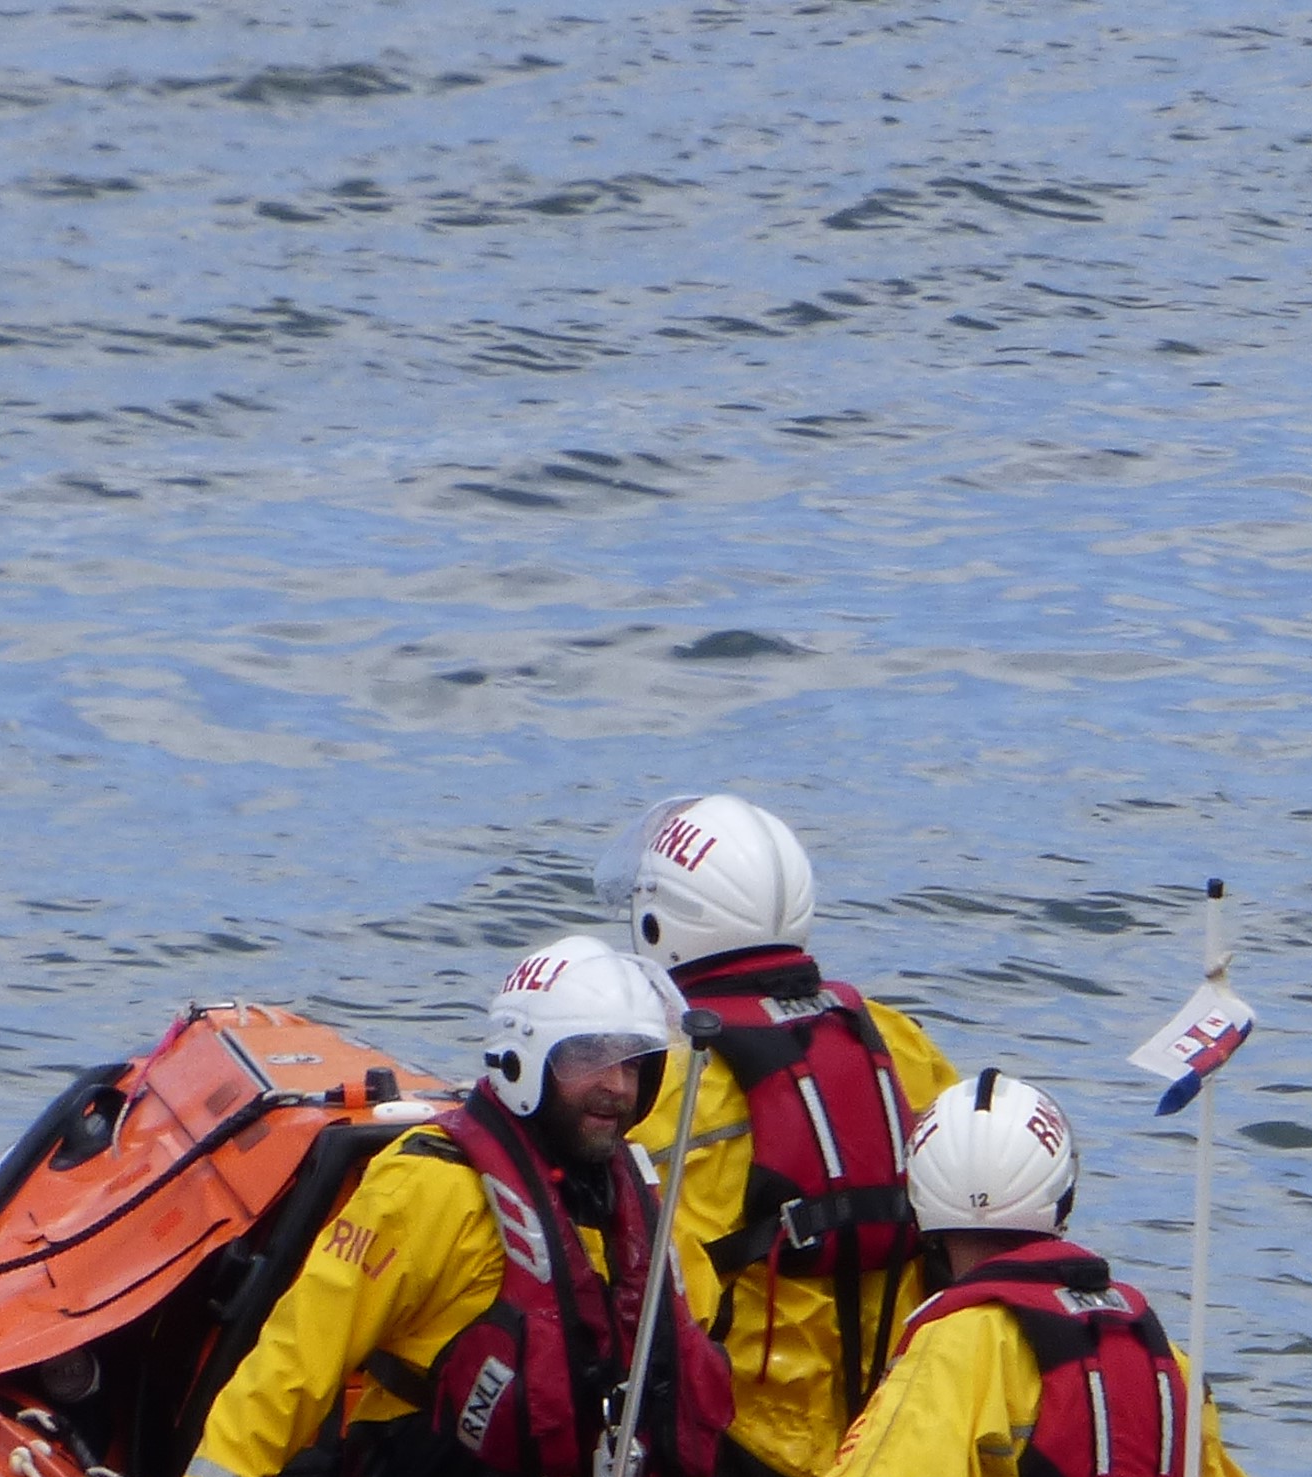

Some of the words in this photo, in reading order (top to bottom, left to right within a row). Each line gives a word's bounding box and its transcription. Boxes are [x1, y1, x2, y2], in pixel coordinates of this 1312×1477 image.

[969, 1192, 990, 1208] 12
[322, 1219, 397, 1280] RNLI
[463, 1369, 503, 1440] RNLI
